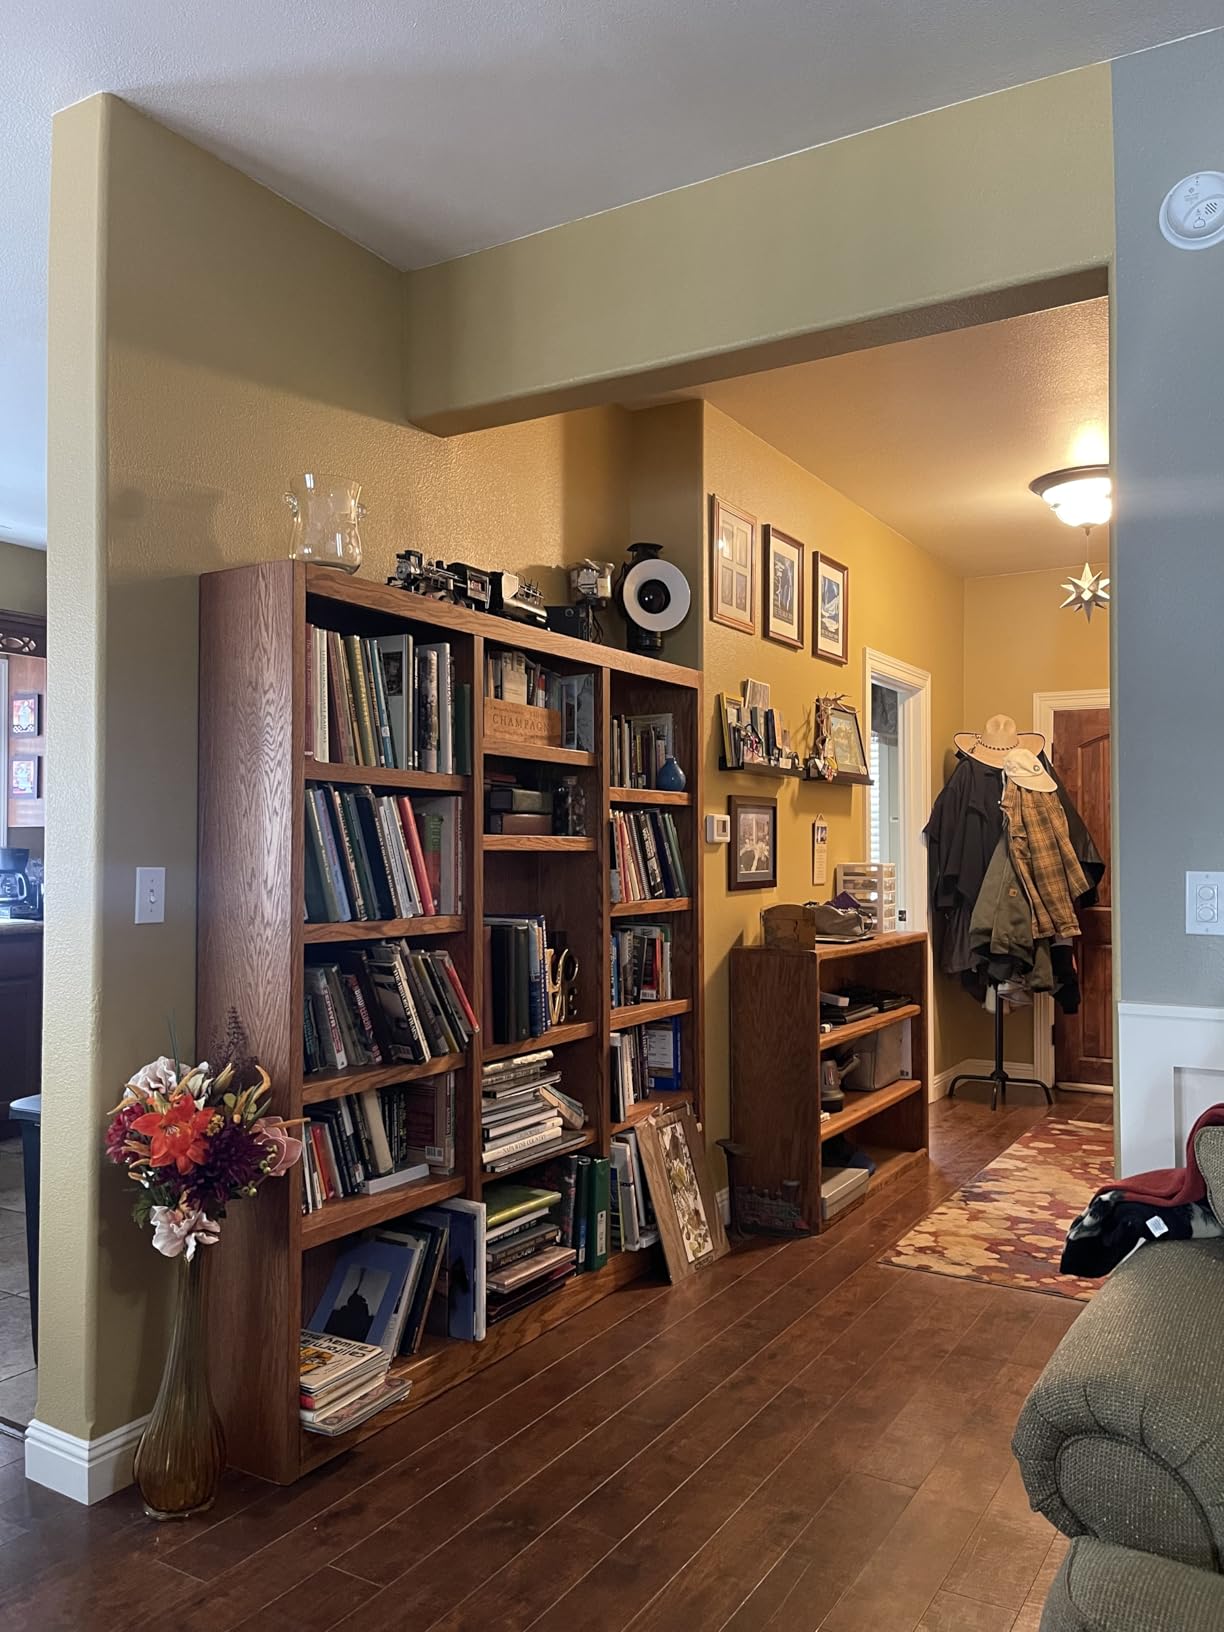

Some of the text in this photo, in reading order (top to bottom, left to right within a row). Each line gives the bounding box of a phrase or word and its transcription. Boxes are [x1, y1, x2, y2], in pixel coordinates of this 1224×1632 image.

[493, 714, 554, 733] CHAMPAGN
[322, 988, 336, 1027] ZEPHYR
[392, 968, 401, 983] THE
[398, 982, 410, 1008] HISTORY
[407, 1016, 419, 1041] TRAINS
[514, 1141, 526, 1150] WINE
[300, 1338, 366, 1358] california
[324, 1337, 376, 1353] railway
